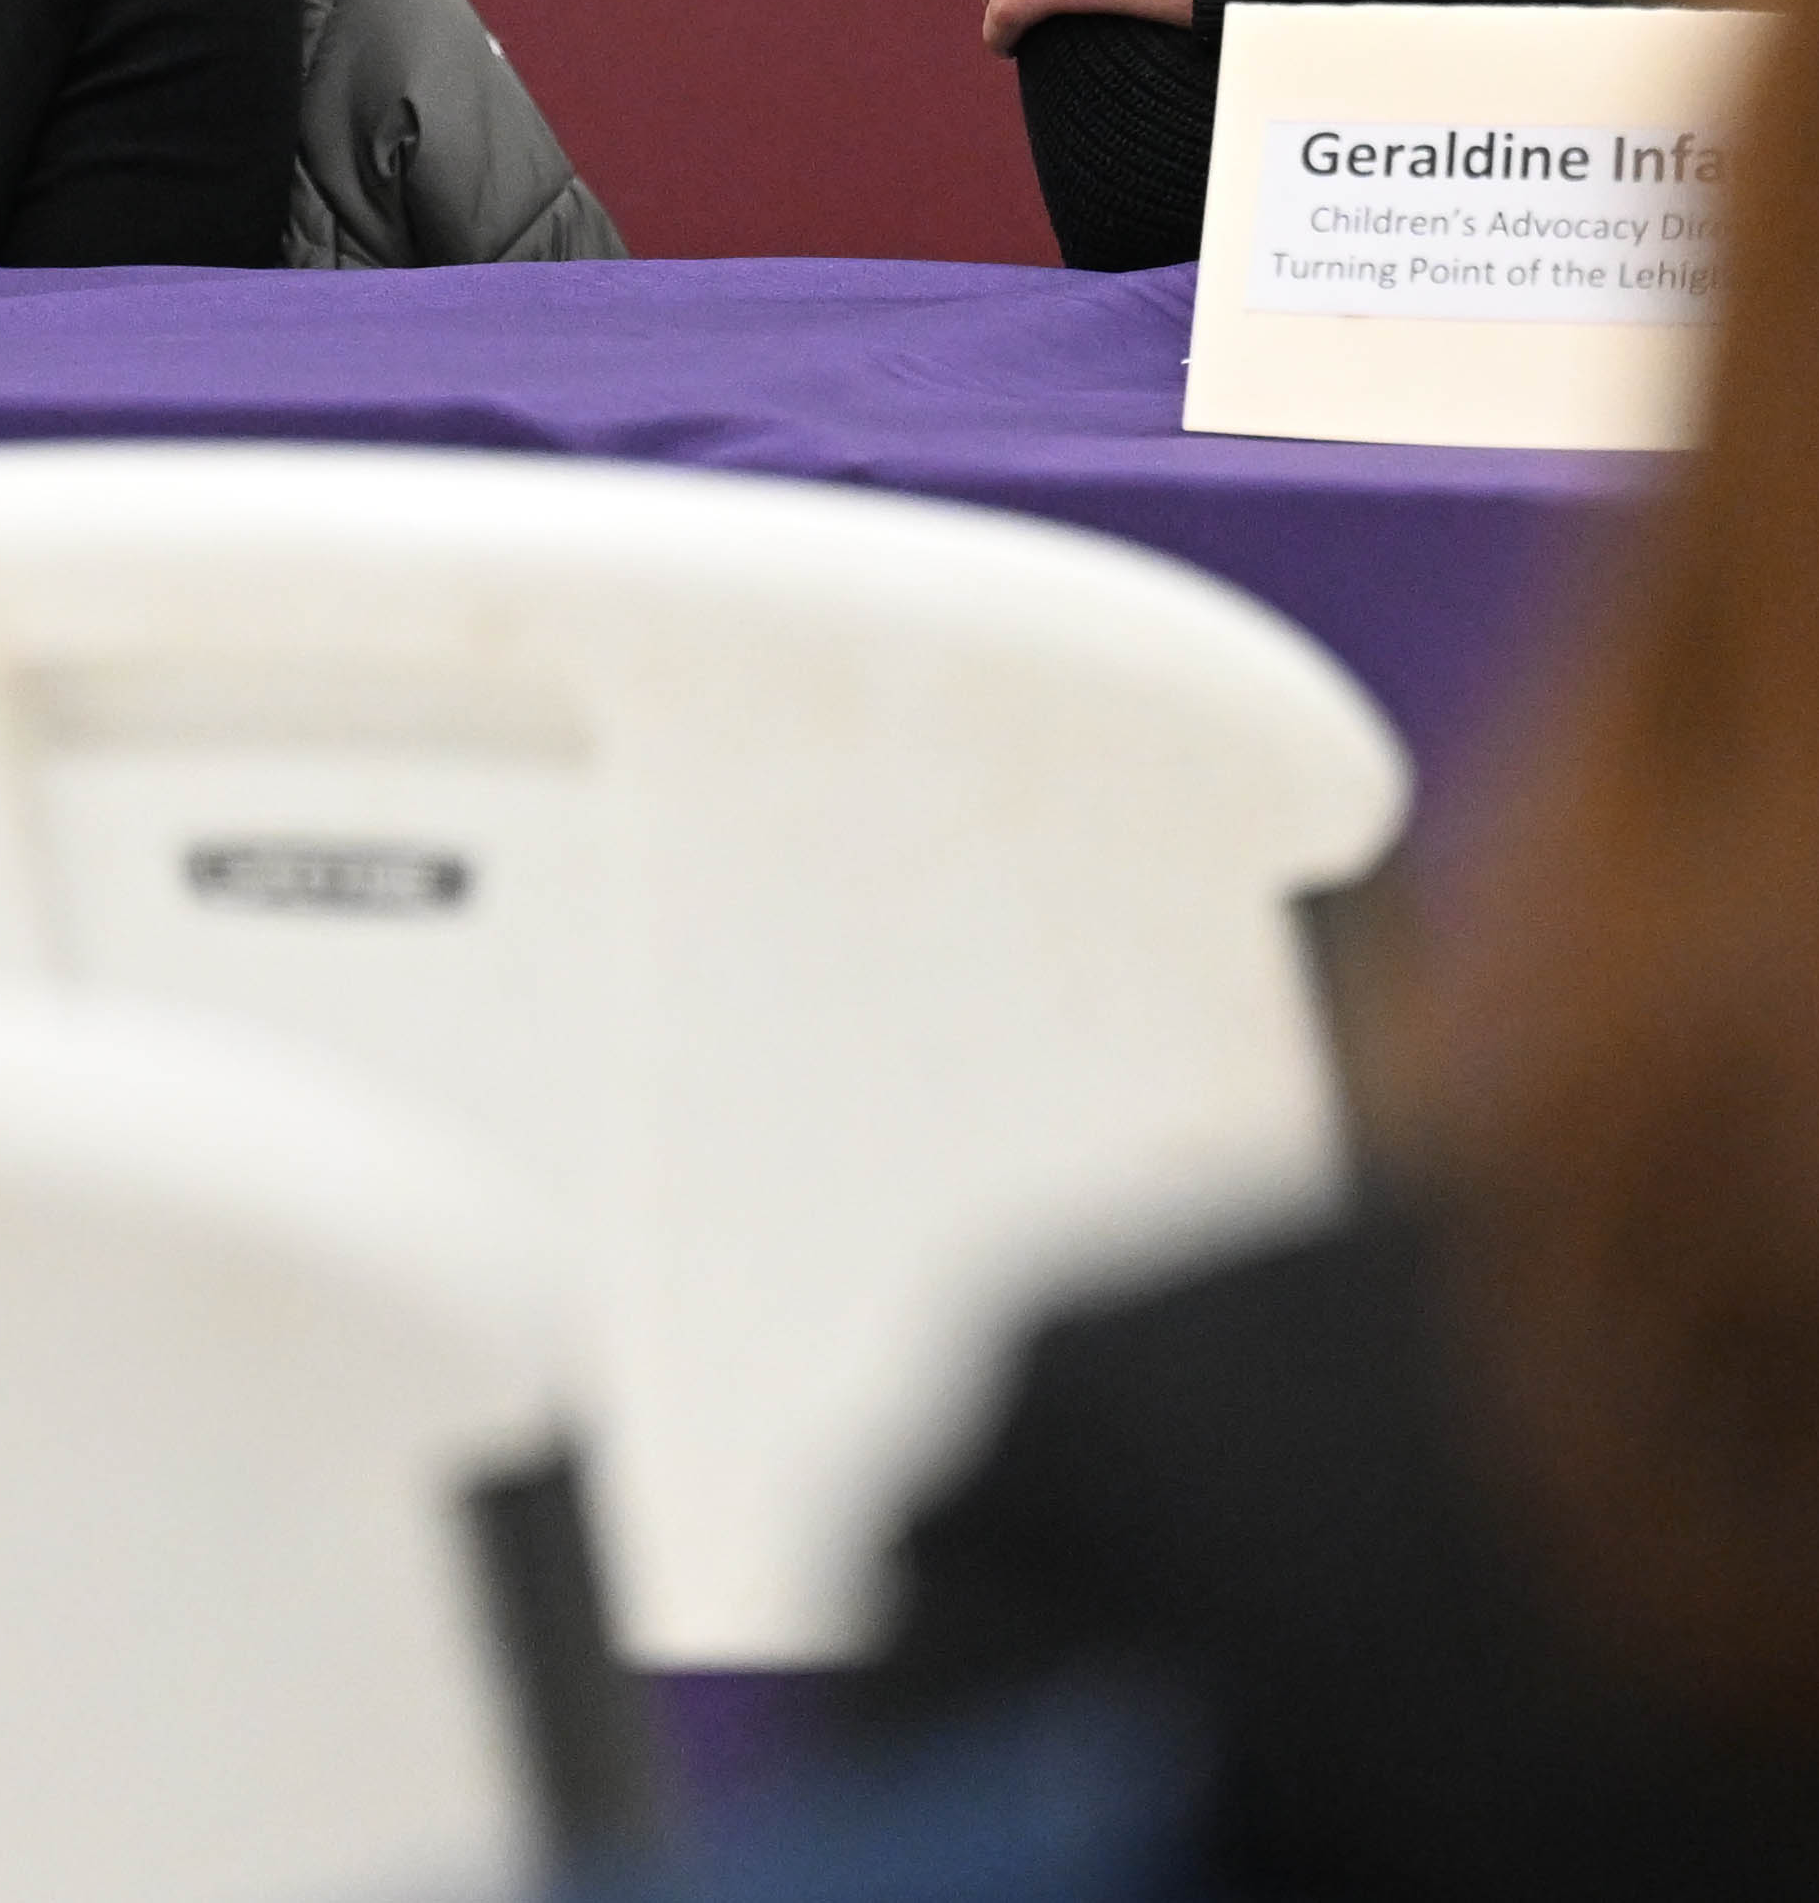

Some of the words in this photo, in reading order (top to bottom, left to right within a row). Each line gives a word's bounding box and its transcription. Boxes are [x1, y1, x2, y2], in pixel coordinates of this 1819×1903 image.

[1301, 131, 1590, 182] Geraldine
[1613, 131, 1723, 184] Infa
[1310, 205, 1477, 237] Children's
[1488, 209, 1649, 247] Advocacy
[1272, 251, 1398, 290] Turning
[1410, 256, 1496, 286] Point
[1506, 258, 1543, 287] of
[1551, 260, 1607, 288] the
